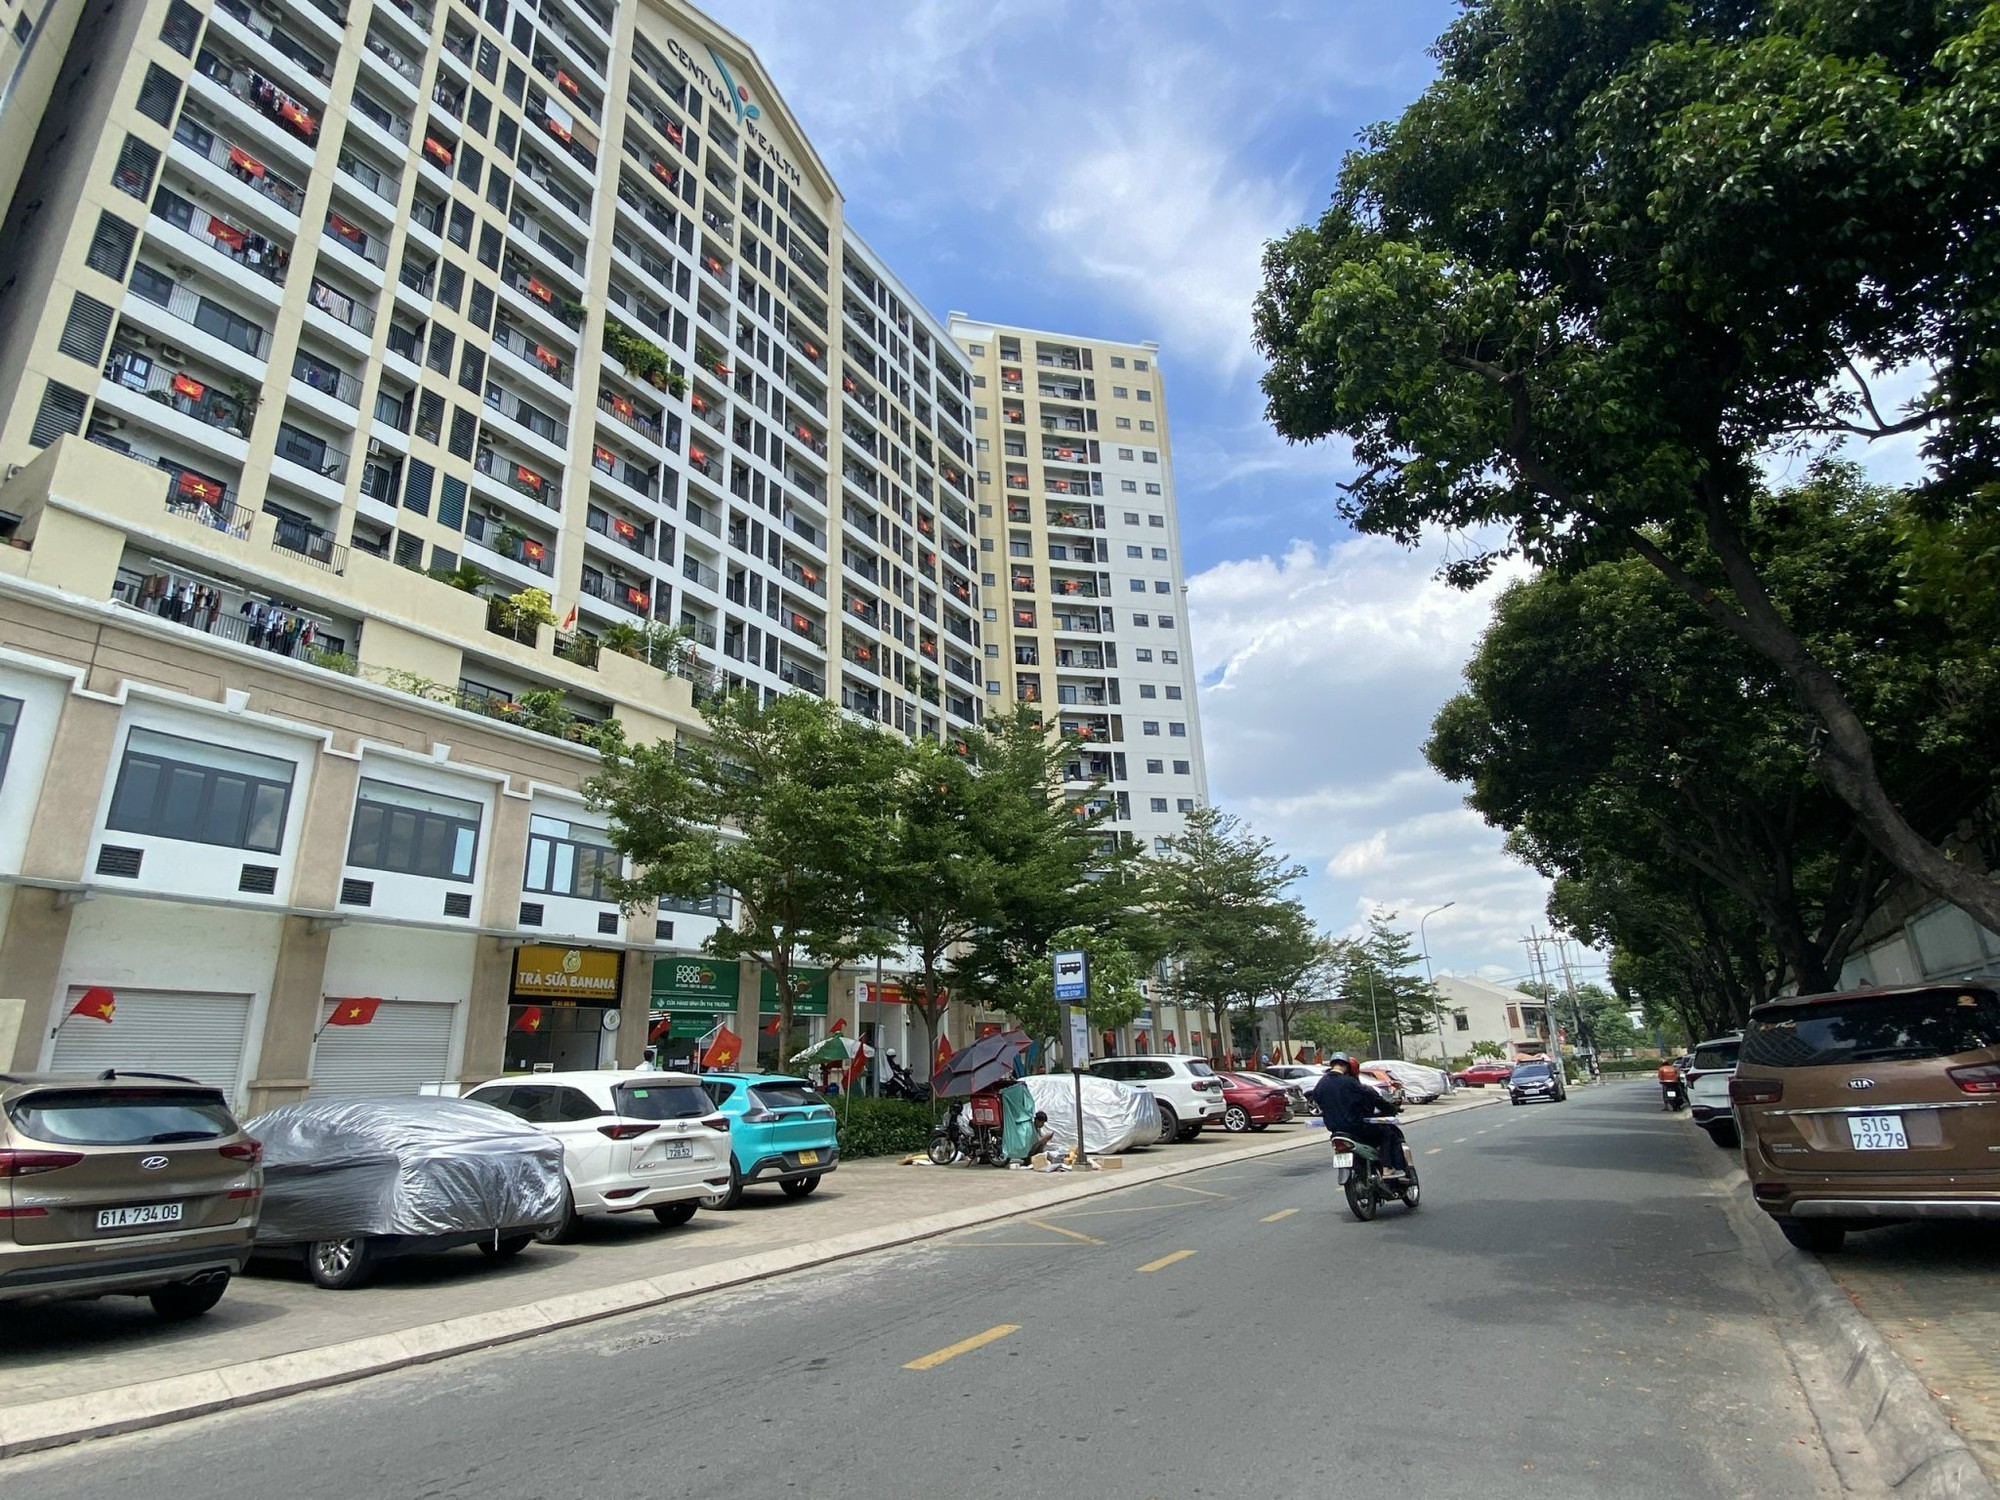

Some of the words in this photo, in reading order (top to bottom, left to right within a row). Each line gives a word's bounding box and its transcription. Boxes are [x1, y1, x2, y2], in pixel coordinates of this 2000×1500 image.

[667, 38, 732, 113] CENTUM
[745, 118, 801, 187] WEALTH
[676, 965, 700, 974] COOP
[519, 969, 542, 985] TRÀ
[544, 971, 568, 987] SỮA
[570, 976, 615, 989] BANANA
[675, 973, 700, 983] FOOD
[1850, 1080, 1871, 1089] KIA
[1861, 1118, 1890, 1132] 51G
[1854, 1133, 1905, 1148] 732.78
[100, 1204, 179, 1227] 61A-734.09
